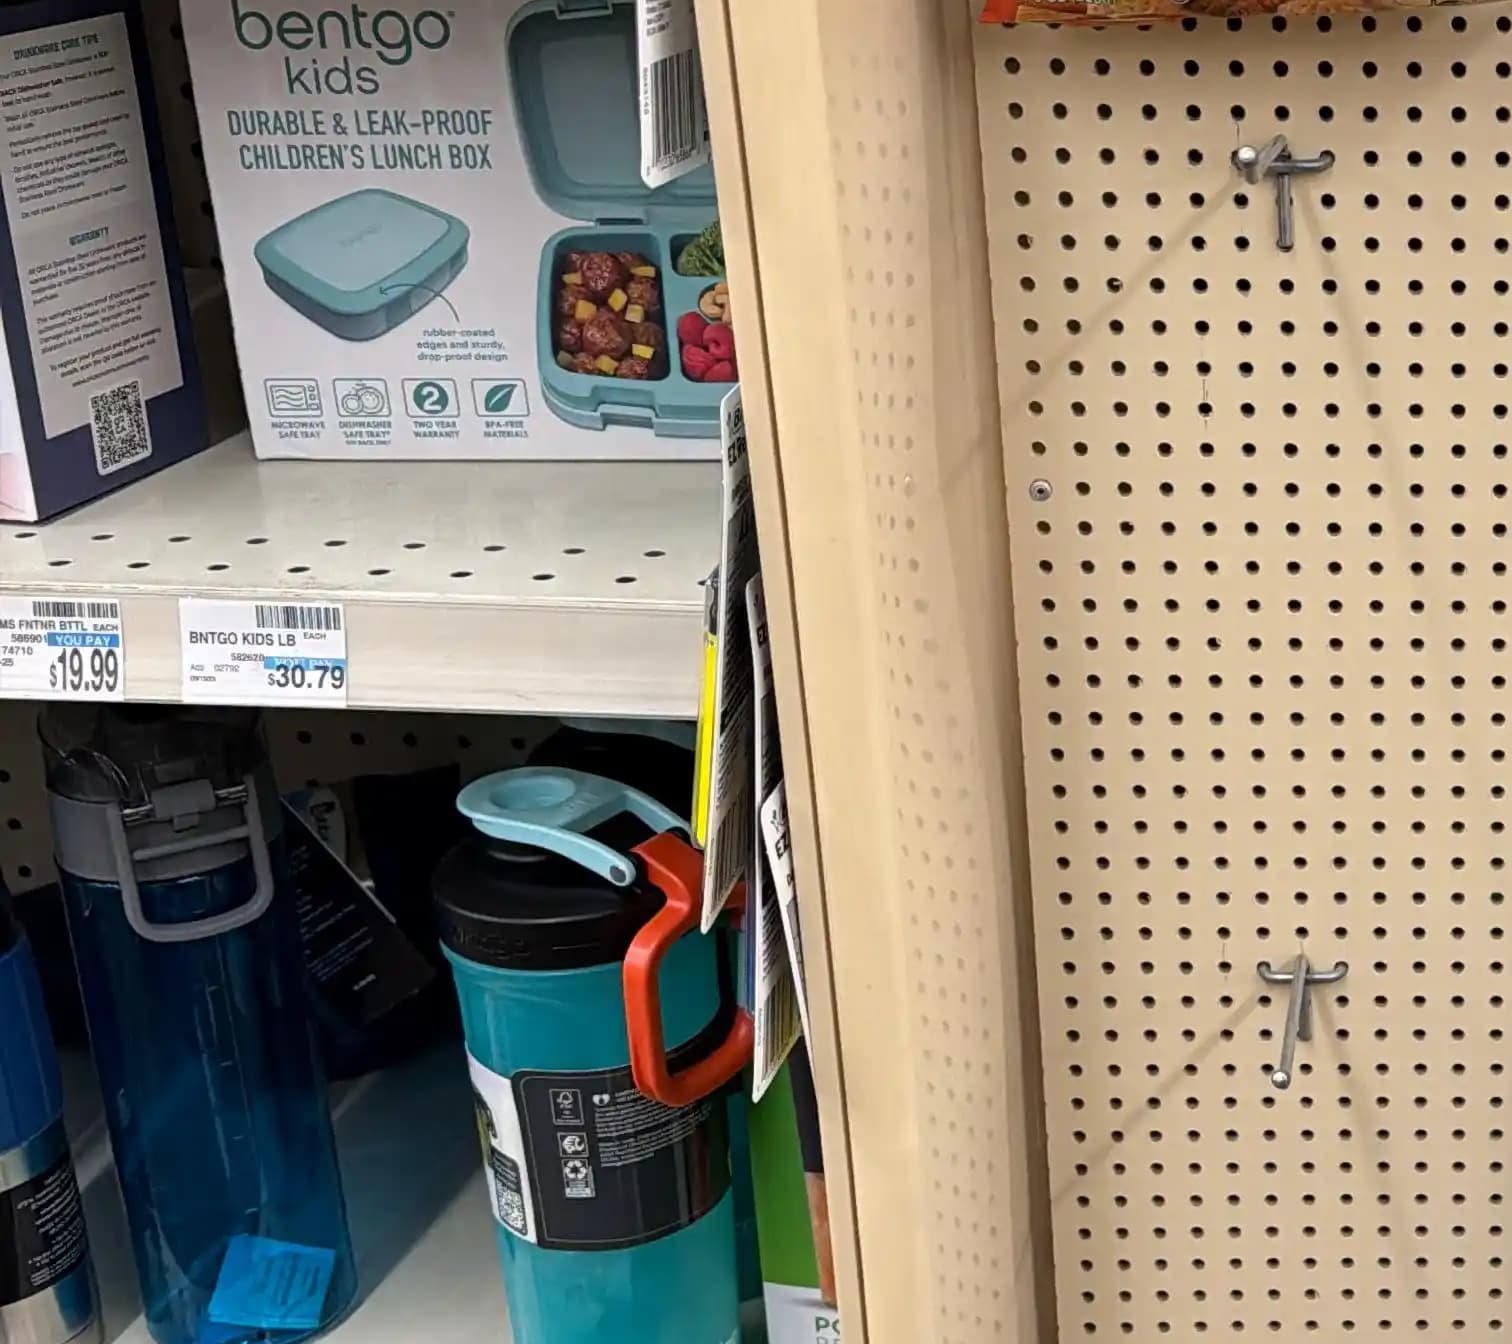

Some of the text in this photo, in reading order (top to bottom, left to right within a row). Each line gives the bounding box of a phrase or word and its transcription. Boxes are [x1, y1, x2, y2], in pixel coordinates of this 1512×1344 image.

[284, 56, 380, 96] kids
[227, 109, 493, 136] DURABLE & LEAK-PROOF
[239, 142, 493, 170] CHILDREN'S LUNCH BOX
[59, 620, 88, 632] BTTL
[189, 631, 327, 647] BNTGO KIDS LB EACH
[54, 635, 111, 647] YOU PAY
[49, 647, 119, 692] $19.99
[267, 664, 345, 690] $30.79
